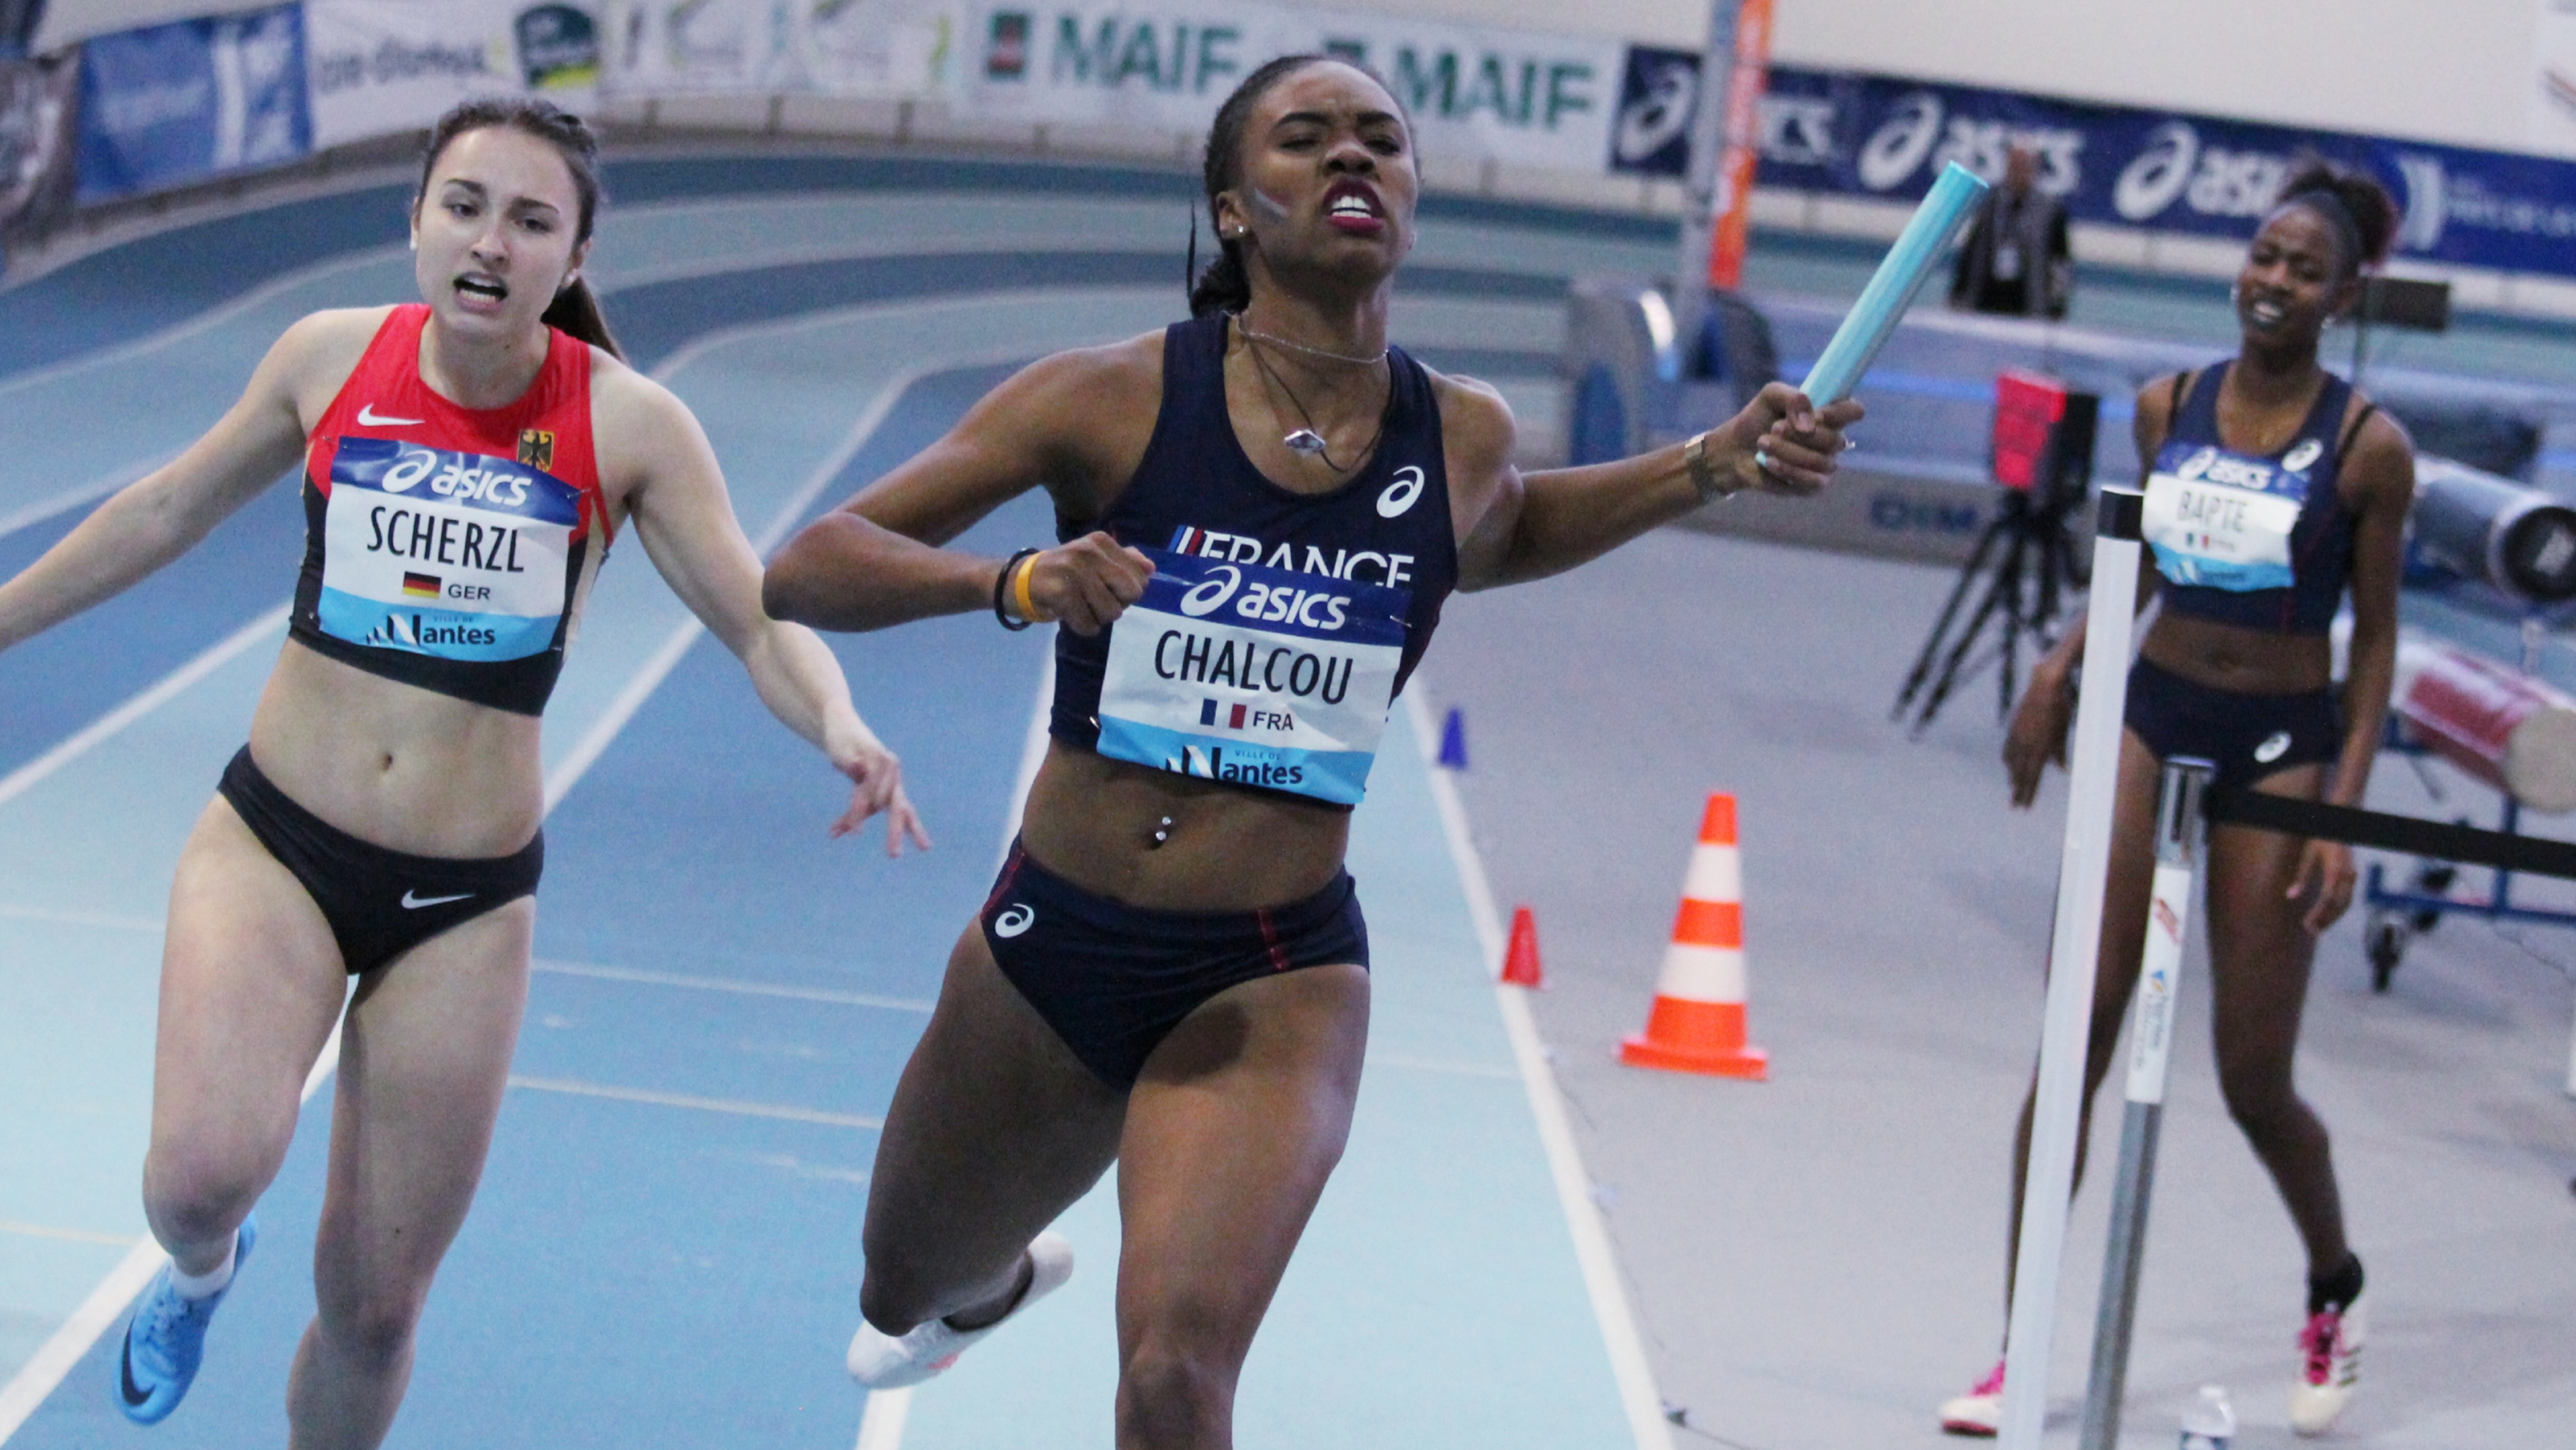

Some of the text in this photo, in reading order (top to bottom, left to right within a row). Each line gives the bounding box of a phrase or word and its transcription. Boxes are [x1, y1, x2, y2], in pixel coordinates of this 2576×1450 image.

[1053, 17, 1239, 94] MAIF
[1392, 48, 1591, 130] MAIF
[431, 465, 533, 507] asics
[366, 505, 525, 573] SCHERZL
[447, 584, 491, 601] GER
[1236, 583, 1351, 631] asics
[386, 614, 496, 647] Nantes
[1155, 630, 1354, 705] CHALCOU
[1252, 711, 1294, 731] FRA
[1182, 745, 1303, 784] Nantes
